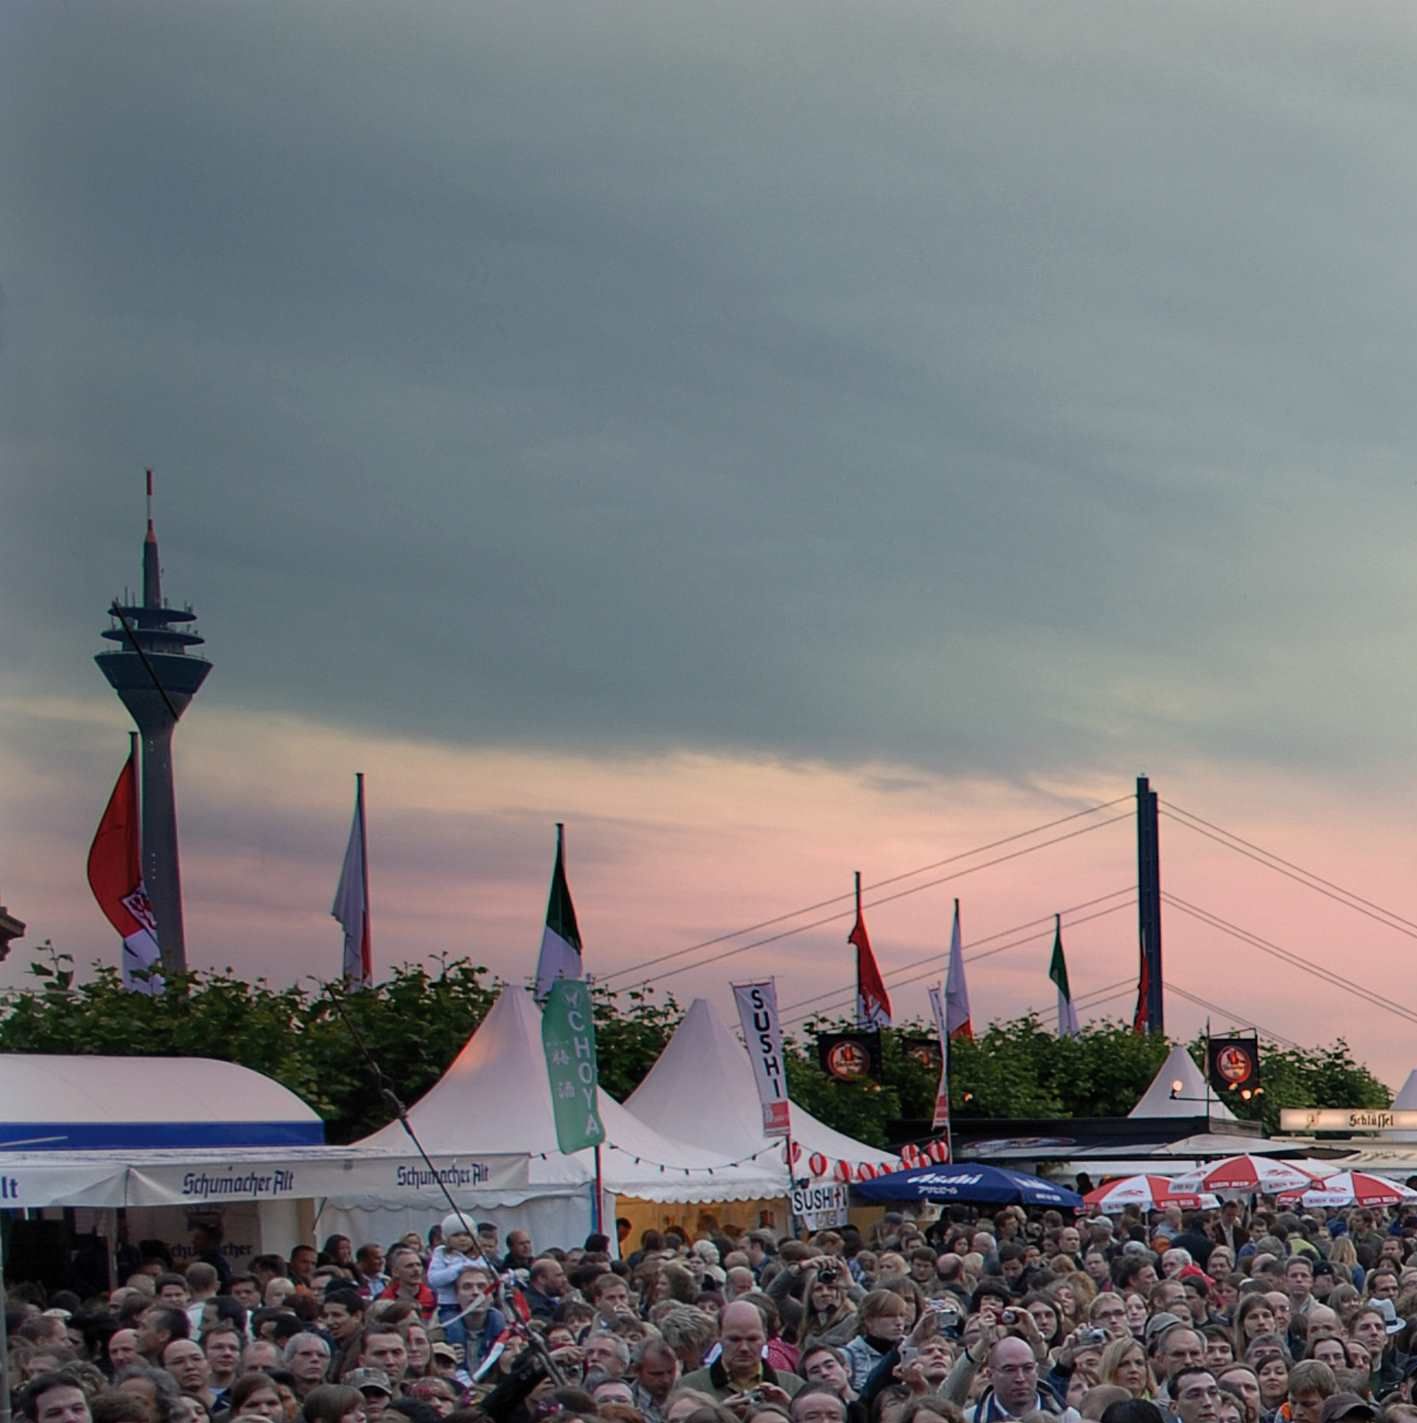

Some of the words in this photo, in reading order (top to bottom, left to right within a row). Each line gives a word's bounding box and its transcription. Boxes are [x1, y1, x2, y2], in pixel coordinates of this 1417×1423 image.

[567, 1011, 600, 1136] CHOYA
[751, 989, 781, 1098] SUSHI
[1, 1176, 18, 1199] lt
[182, 1171, 271, 1198] Schumacher
[273, 1170, 294, 1195] Alt
